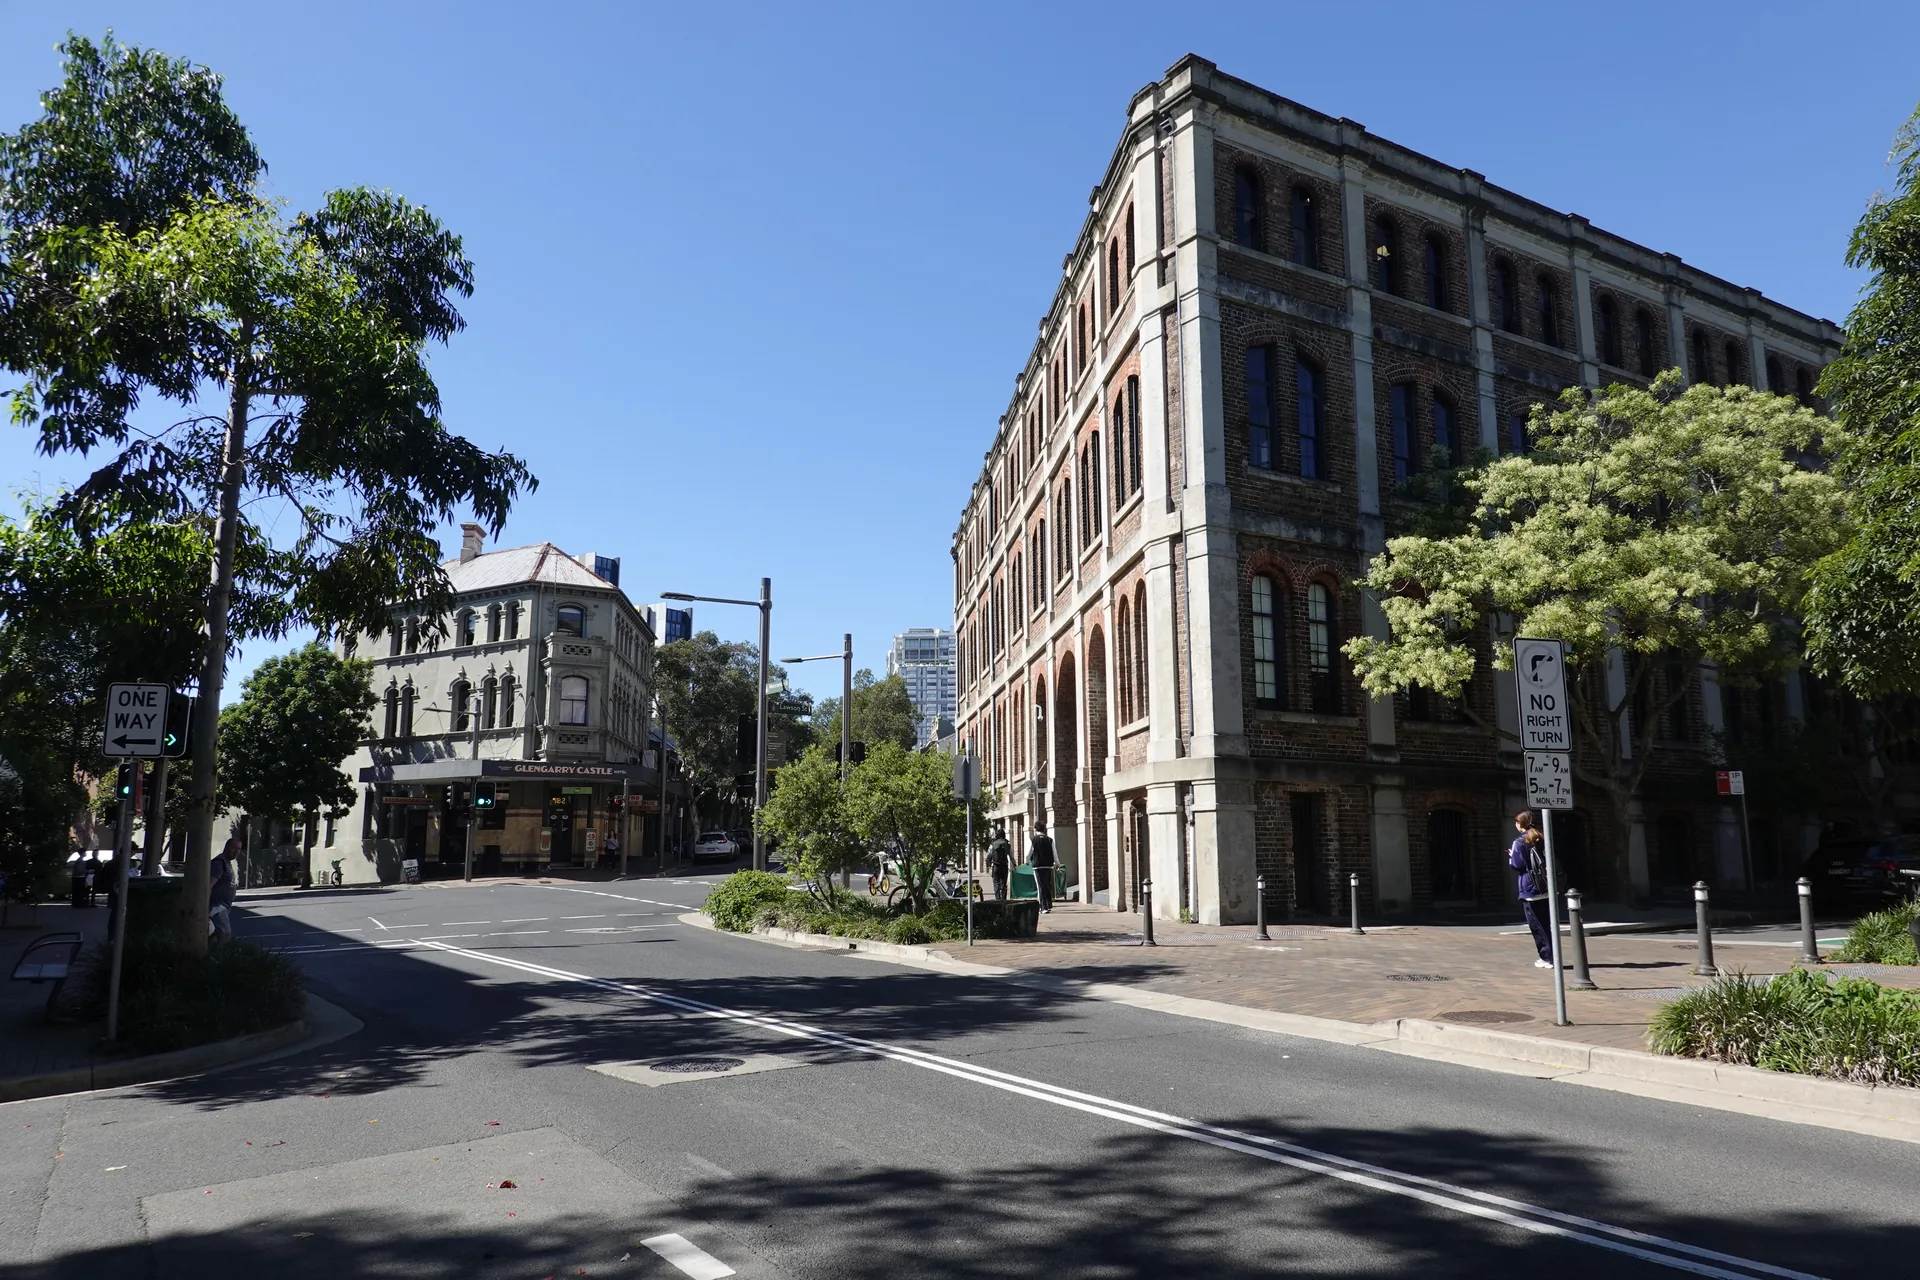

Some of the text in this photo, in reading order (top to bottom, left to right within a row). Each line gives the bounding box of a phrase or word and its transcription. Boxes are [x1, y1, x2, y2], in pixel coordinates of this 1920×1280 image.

[119, 691, 158, 707] ONE
[1530, 694, 1556, 711] NO
[115, 713, 158, 729] WAY
[1527, 715, 1562, 727] RIGHT
[1530, 732, 1563, 743] TURN
[514, 764, 575, 774] GLENGARRY
[576, 766, 613, 775] CASTLE
[552, 797, 566, 805] 182
